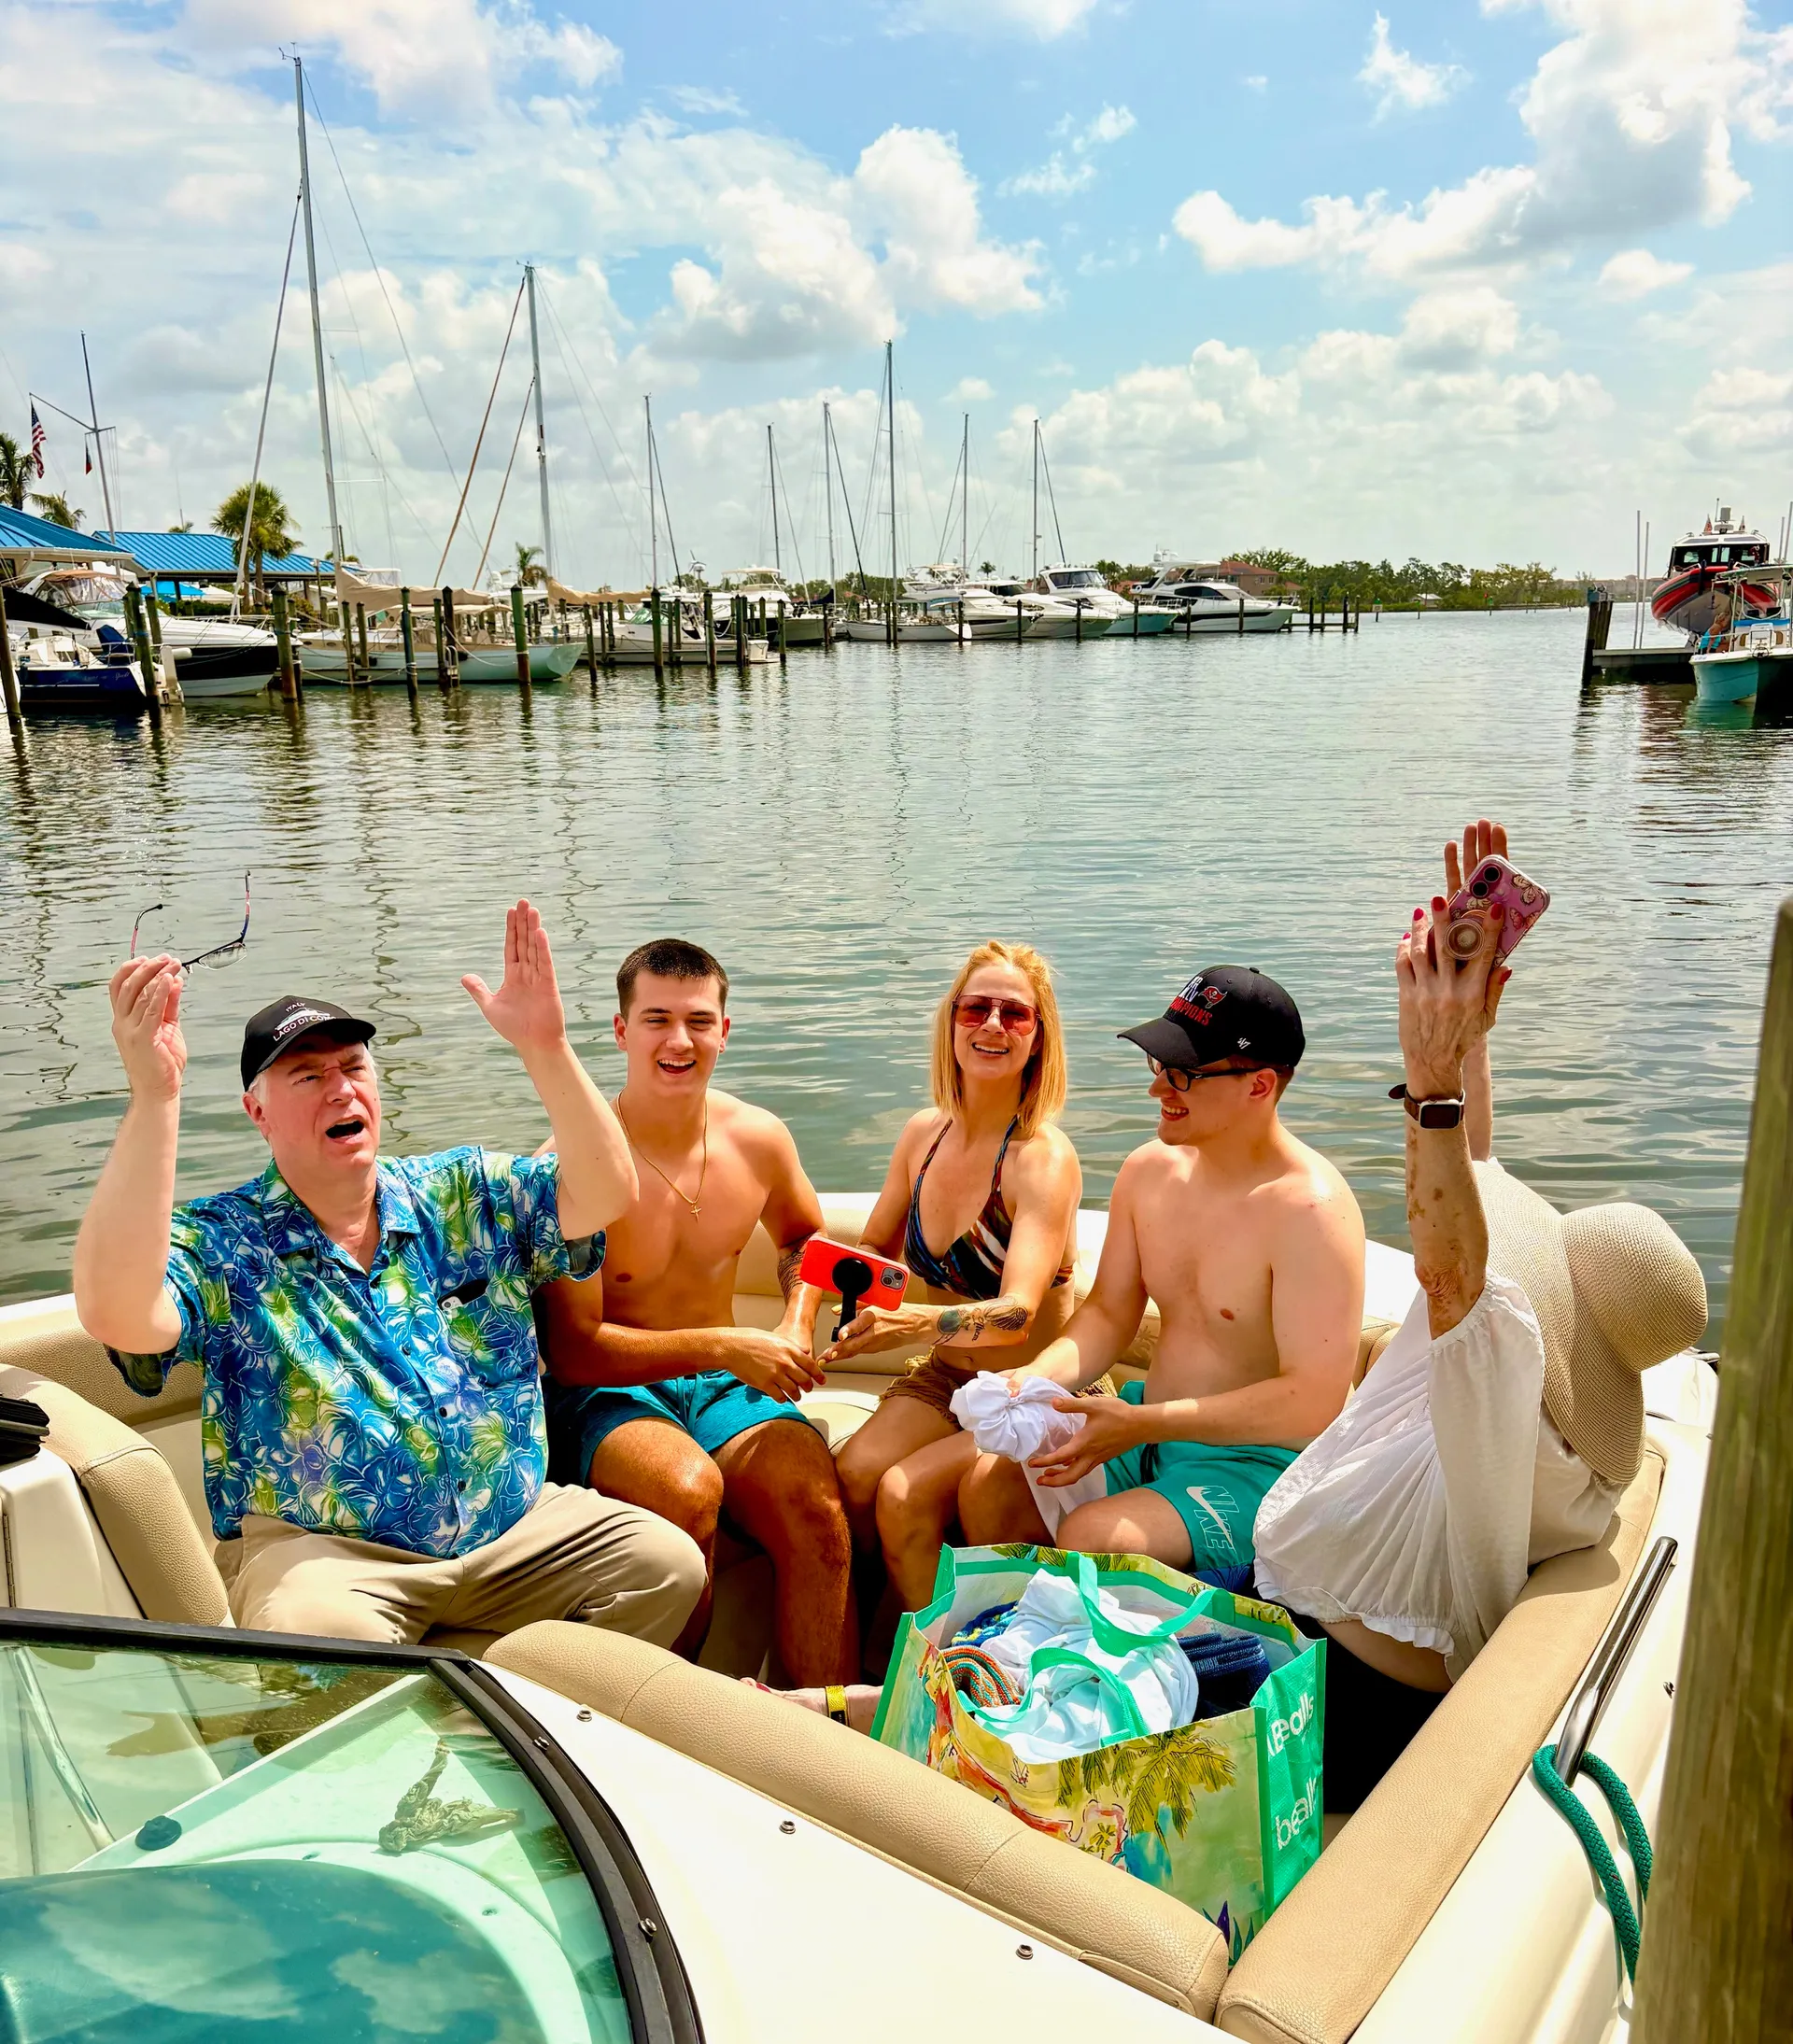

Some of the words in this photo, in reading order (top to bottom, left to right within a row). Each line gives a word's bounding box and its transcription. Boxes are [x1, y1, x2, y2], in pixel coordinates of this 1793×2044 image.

[285, 1002, 305, 1012] ITALY
[1170, 996, 1213, 1026] MPIONS
[273, 1022, 297, 1041] LAGO
[297, 1016, 309, 1025] DI
[1193, 1486, 1240, 1550] NIKE
[1275, 1777, 1318, 1851] beall
